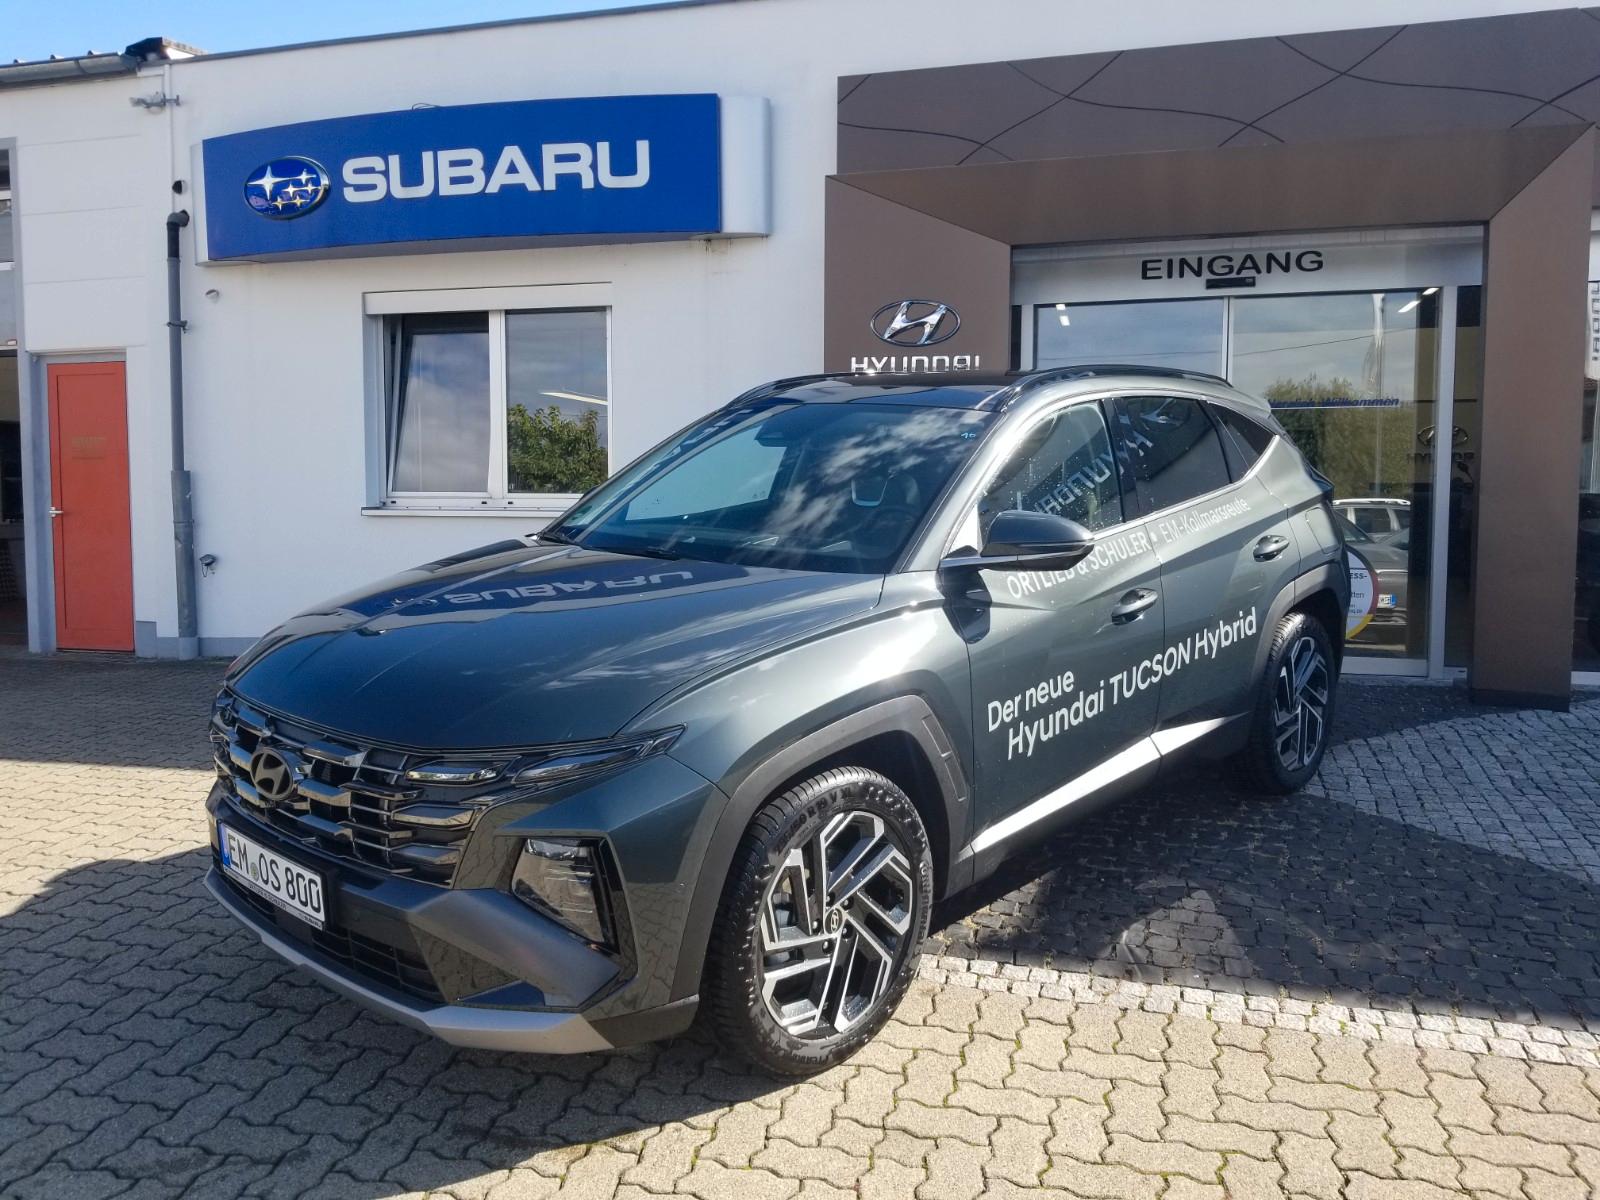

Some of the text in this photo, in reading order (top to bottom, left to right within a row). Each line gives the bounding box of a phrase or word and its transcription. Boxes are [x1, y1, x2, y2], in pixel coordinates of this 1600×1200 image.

[342, 140, 650, 202] SUBARU
[1141, 250, 1324, 280] EINGANG
[850, 355, 980, 373] HYUNDAI
[1088, 531, 1153, 571] SCHULER
[1159, 497, 1251, 544] EM-Kollmarsreute
[988, 671, 1074, 732] Der neue
[1008, 607, 1257, 760] Hyundai TUCSON Hybrid
[228, 832, 250, 875] EM
[259, 852, 281, 893] OS
[285, 866, 321, 914] 800
